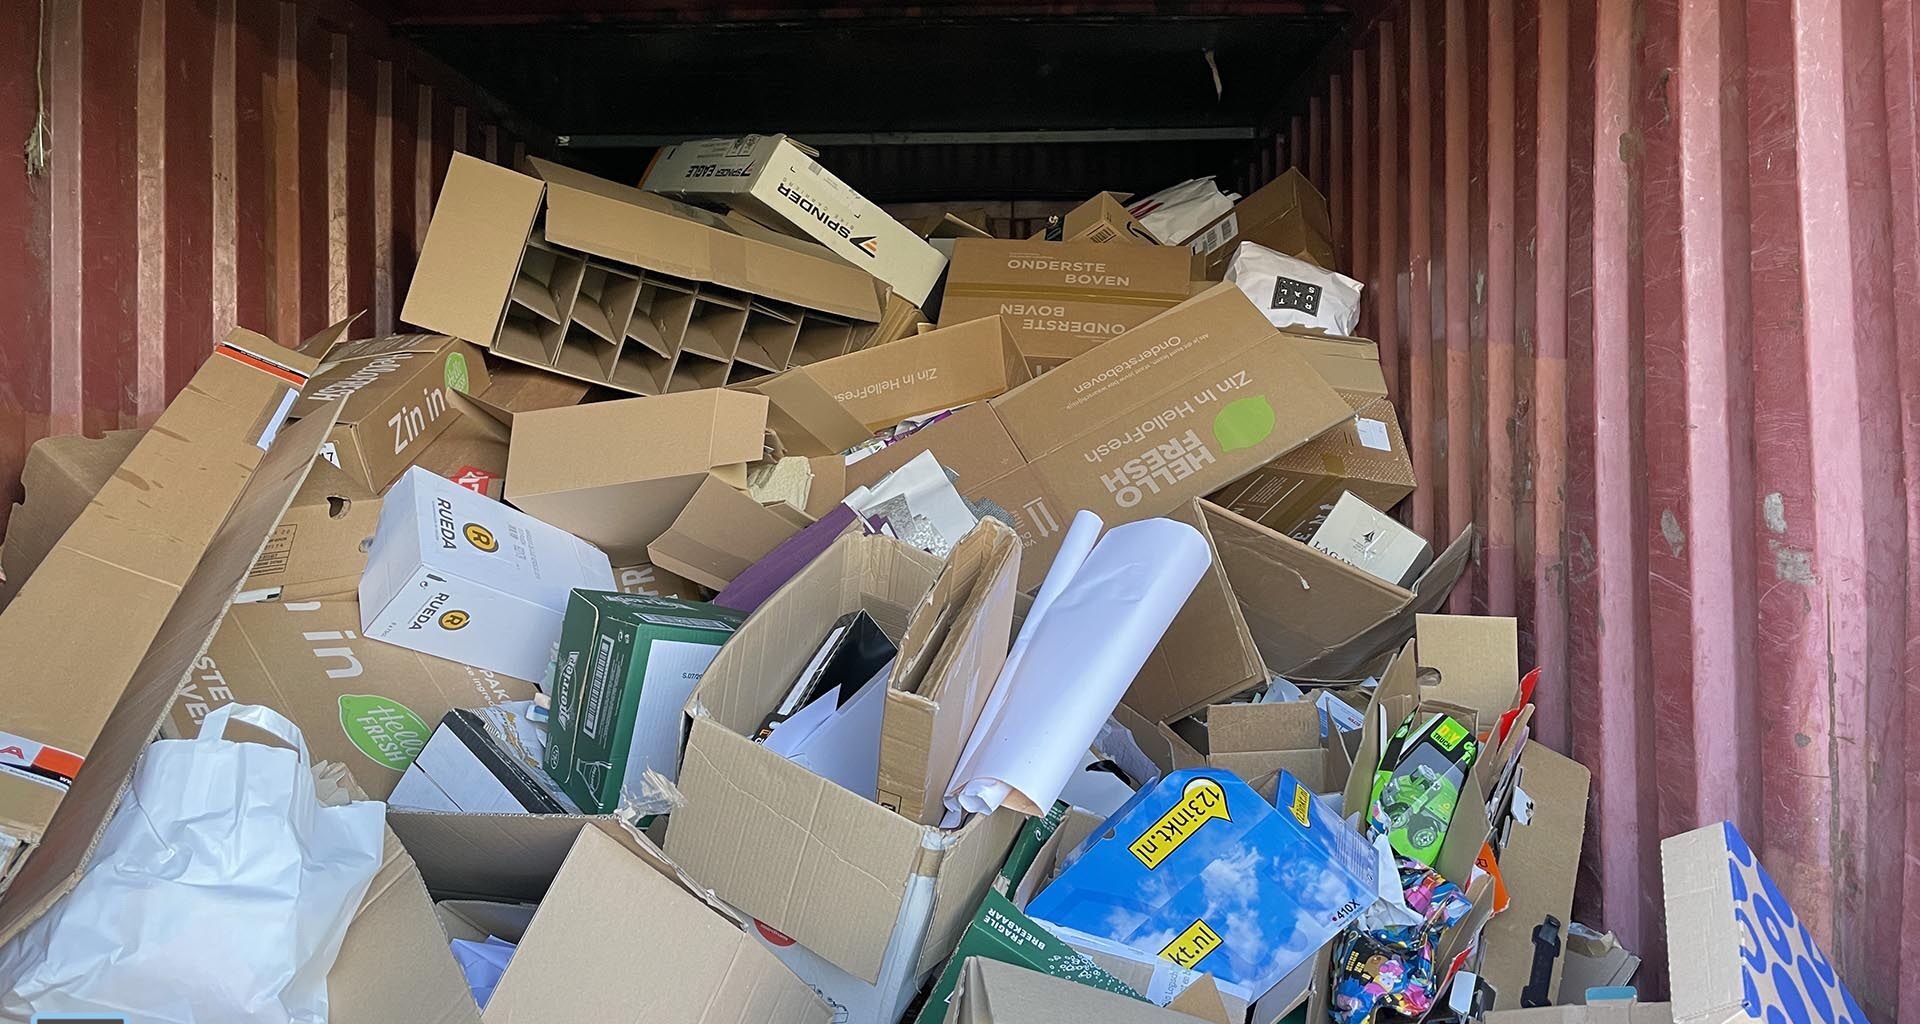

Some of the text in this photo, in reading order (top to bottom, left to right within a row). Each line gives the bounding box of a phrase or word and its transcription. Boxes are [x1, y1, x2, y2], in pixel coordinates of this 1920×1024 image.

[777, 182, 851, 239] SPINDER
[1007, 259, 1106, 273] ONDERSTE
[1064, 274, 1130, 287] BOVEN
[1000, 303, 1065, 317] BOVEN
[1022, 318, 1126, 335] ONDERSTE
[834, 368, 937, 402] Zin In HelloFres
[1073, 335, 1182, 395] Ondersteboven
[388, 387, 446, 455] Zin in
[1083, 370, 1253, 464] Zin In HelloFresh
[1100, 429, 1202, 493] FRESH
[1115, 445, 1217, 508] HELLO
[436, 497, 457, 549] RUEDA
[408, 592, 450, 631] RUEDA
[302, 630, 364, 679] in
[357, 716, 407, 765] FRESH
[367, 703, 422, 761] Hello
[1433, 732, 1453, 750] TRUCK
[1134, 786, 1222, 865] 123inkt.nl
[983, 915, 1024, 946] FRAGILE
[987, 907, 1046, 950] BREEKBAAR
[1337, 899, 1361, 922] 410X
